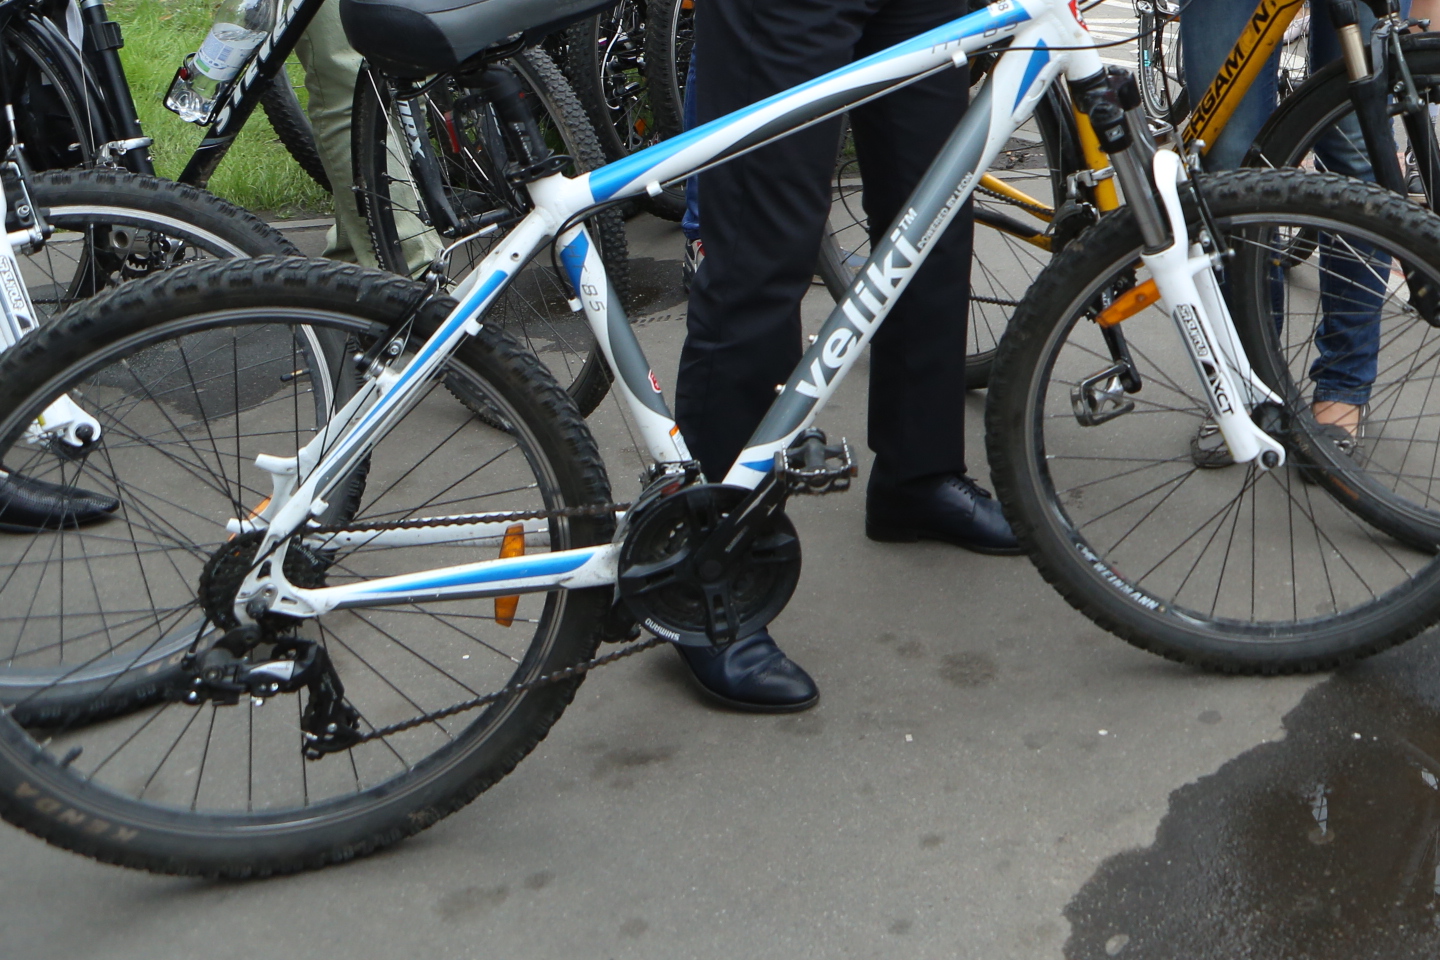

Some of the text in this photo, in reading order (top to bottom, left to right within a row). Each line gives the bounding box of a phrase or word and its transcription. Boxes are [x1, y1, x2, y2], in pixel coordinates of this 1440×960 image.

[917, 207, 949, 249] POWERED
[954, 171, 974, 196] LEON
[796, 226, 922, 399] veliki
[1211, 380, 1234, 416] XCT
[1093, 561, 1159, 610] WEINMANN
[644, 618, 680, 641] SHIMANO
